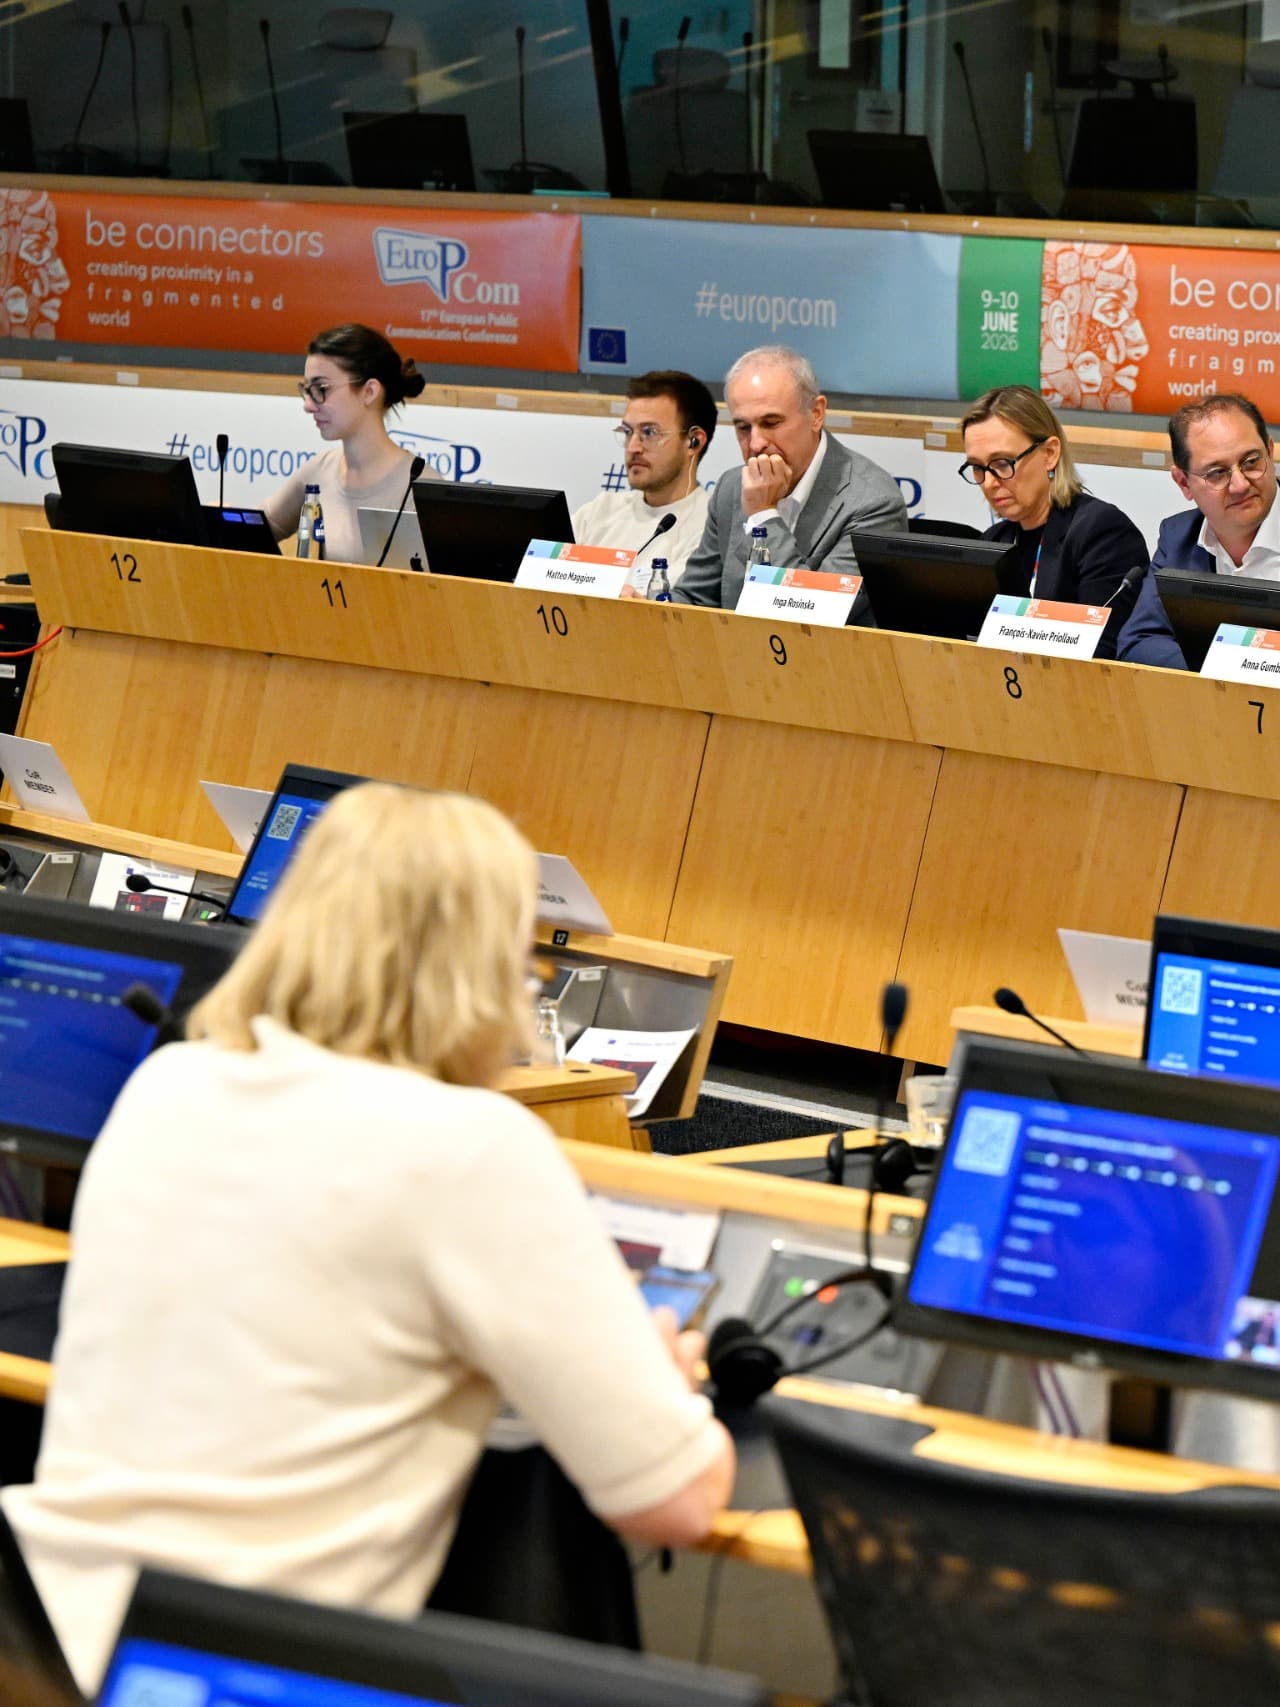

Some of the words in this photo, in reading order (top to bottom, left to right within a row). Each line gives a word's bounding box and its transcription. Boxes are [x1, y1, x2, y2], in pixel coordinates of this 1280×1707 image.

[86, 209, 126, 247] be
[136, 222, 325, 258] connectors
[86, 261, 148, 280] creating
[151, 263, 222, 284] proximity
[226, 267, 241, 282] in
[244, 271, 253, 284] a
[1169, 264, 1216, 308] be
[694, 281, 837, 333] #europcom
[981, 289, 1019, 309] 9-10
[87, 309, 131, 327] world
[439, 310, 486, 328] European
[487, 312, 519, 328] Public
[981, 311, 1019, 333] JUNE
[385, 324, 462, 341] Communication
[462, 329, 519, 344] Conference
[981, 332, 1019, 351] 2026
[1168, 323, 1239, 347] creating
[1168, 379, 1217, 396] world
[110, 552, 142, 583] 12
[546, 569, 567, 582] Matteo
[568, 573, 597, 585] Maggiore
[321, 578, 349, 609] 11
[772, 596, 787, 609] Inga
[536, 604, 569, 637] 10
[998, 625, 1049, 641] François-Xavier
[1048, 631, 1080, 645] Priollaud
[768, 633, 788, 666] 9
[1240, 658, 1260, 671] Anna
[1003, 666, 1023, 699] 8
[1247, 700, 1265, 735] 7
